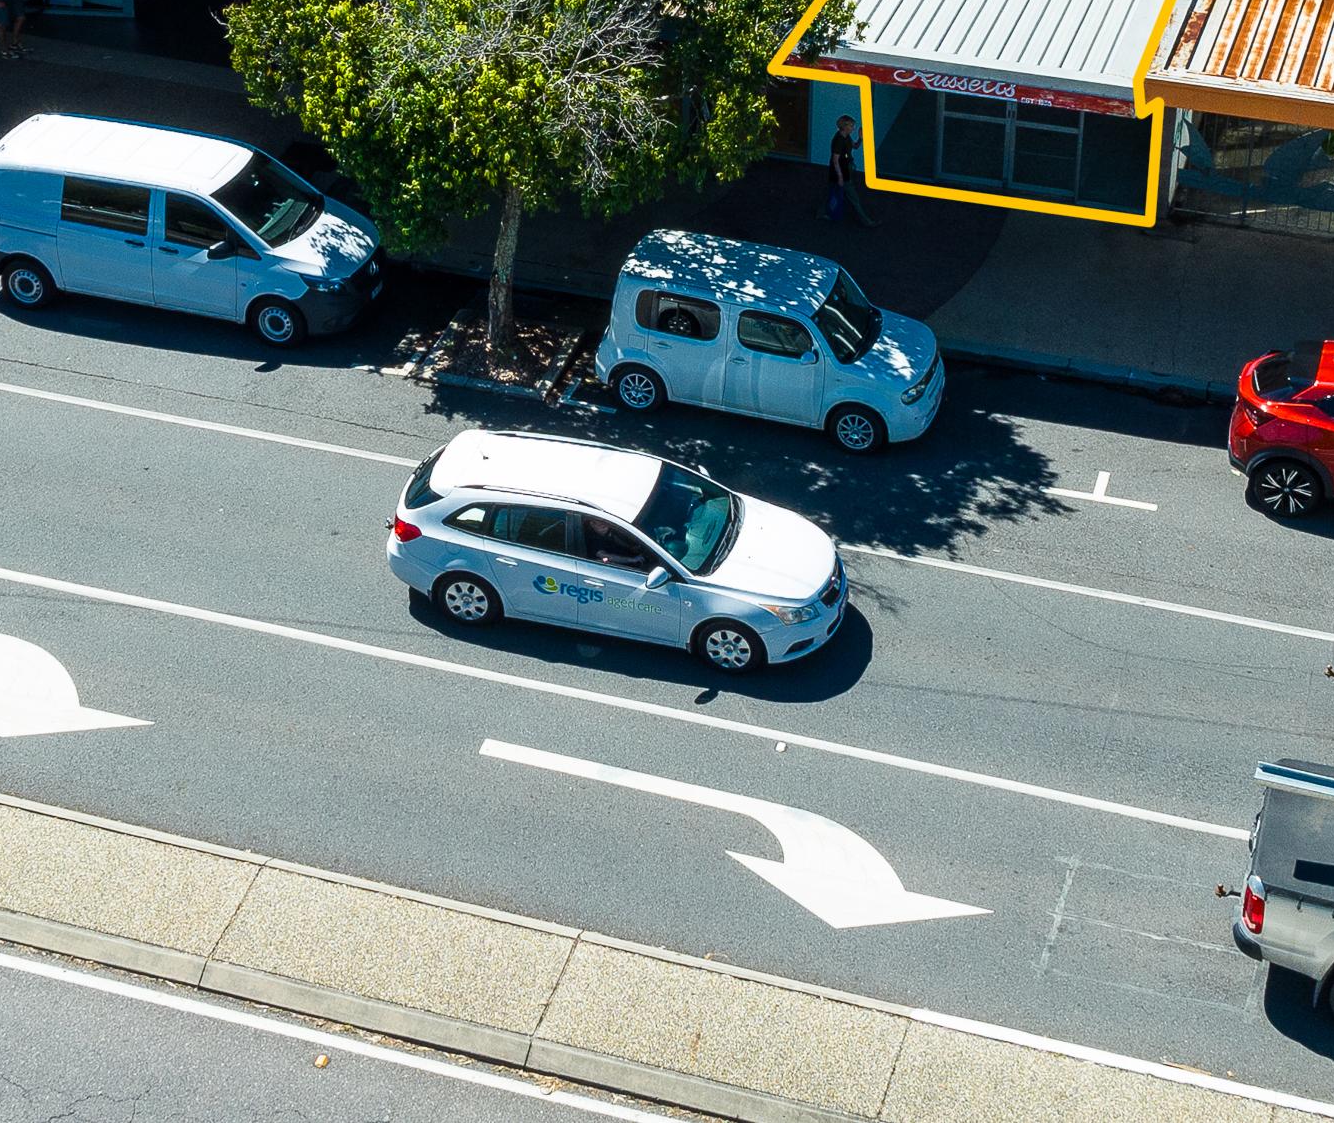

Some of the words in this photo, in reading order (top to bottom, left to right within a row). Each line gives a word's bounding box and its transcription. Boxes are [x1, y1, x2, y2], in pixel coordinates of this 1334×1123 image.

[560, 582, 604, 604] regis
[607, 596, 635, 609] aged
[637, 601, 662, 614] care
